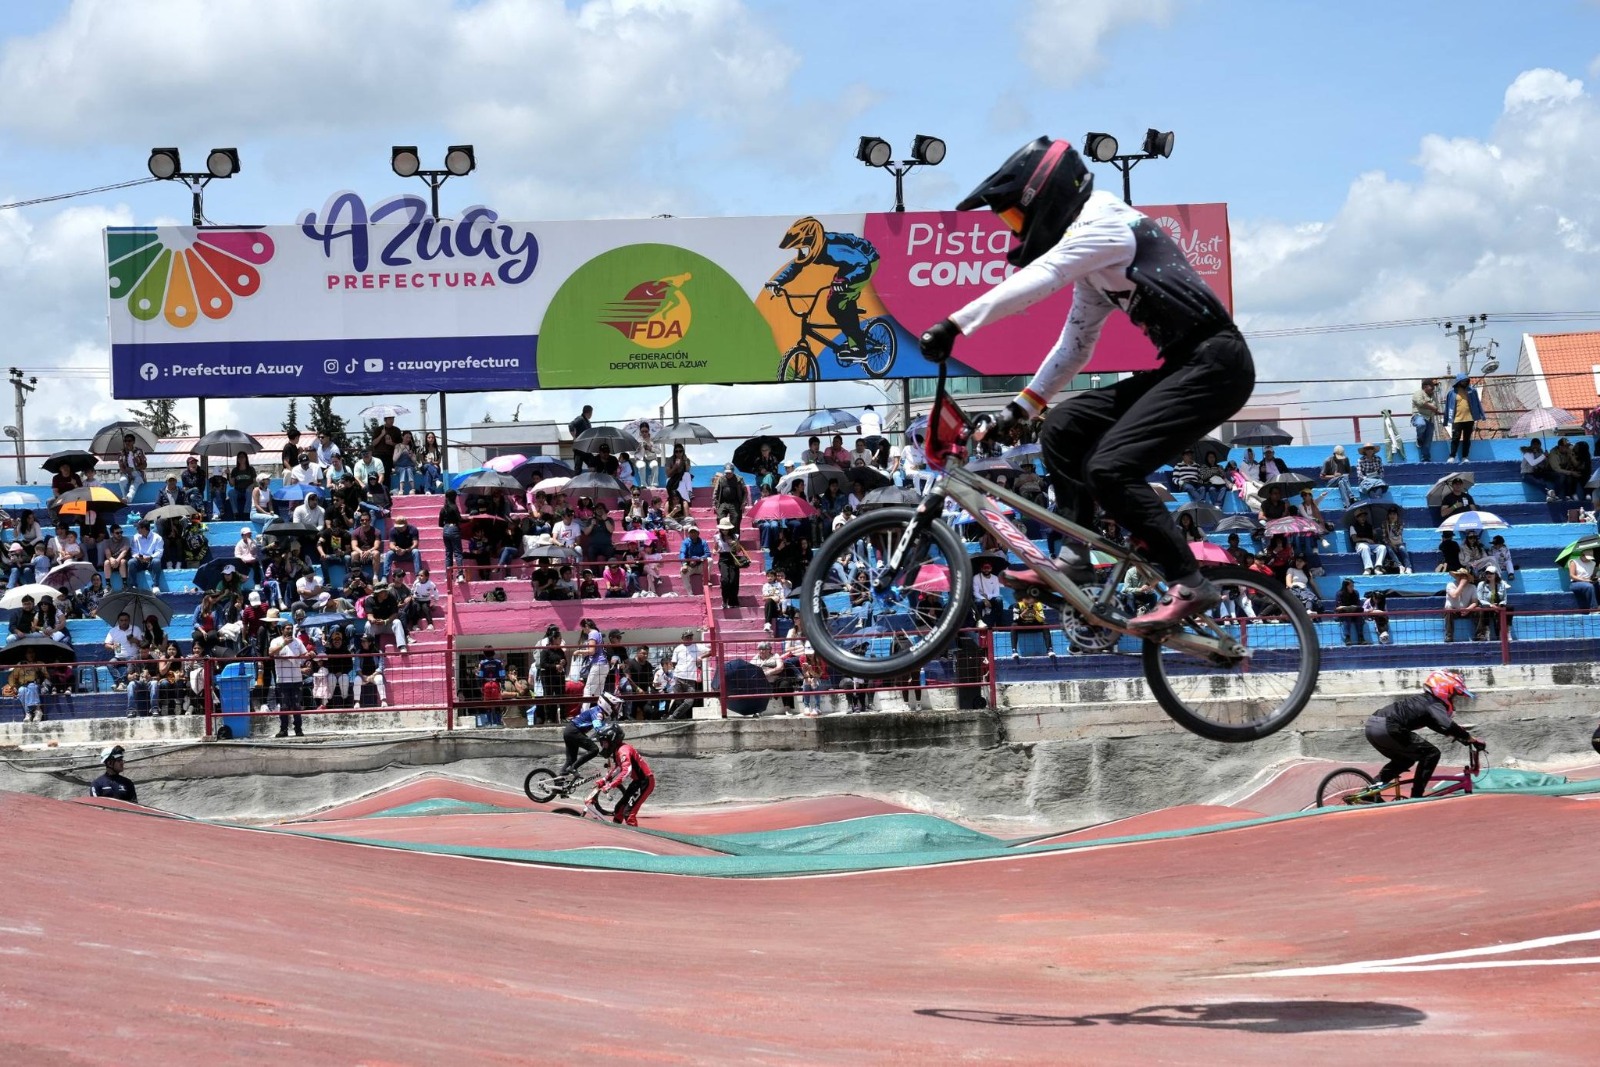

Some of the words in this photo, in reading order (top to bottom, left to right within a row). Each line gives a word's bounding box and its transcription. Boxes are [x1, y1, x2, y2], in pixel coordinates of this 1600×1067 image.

[907, 223, 1011, 255] Pista
[1181, 229, 1223, 253] Visit
[327, 272, 496, 290] PREFECTURA
[630, 320, 683, 339] FDA
[397, 355, 520, 373] azuayprefectura
[629, 350, 689, 361] FEDERACIÓN
[172, 363, 252, 377] Prefectura
[255, 362, 304, 377] Azuay
[609, 362, 659, 370] DEPORTIVA
[660, 361, 677, 369] DEL
[678, 360, 708, 369] AZUAY
